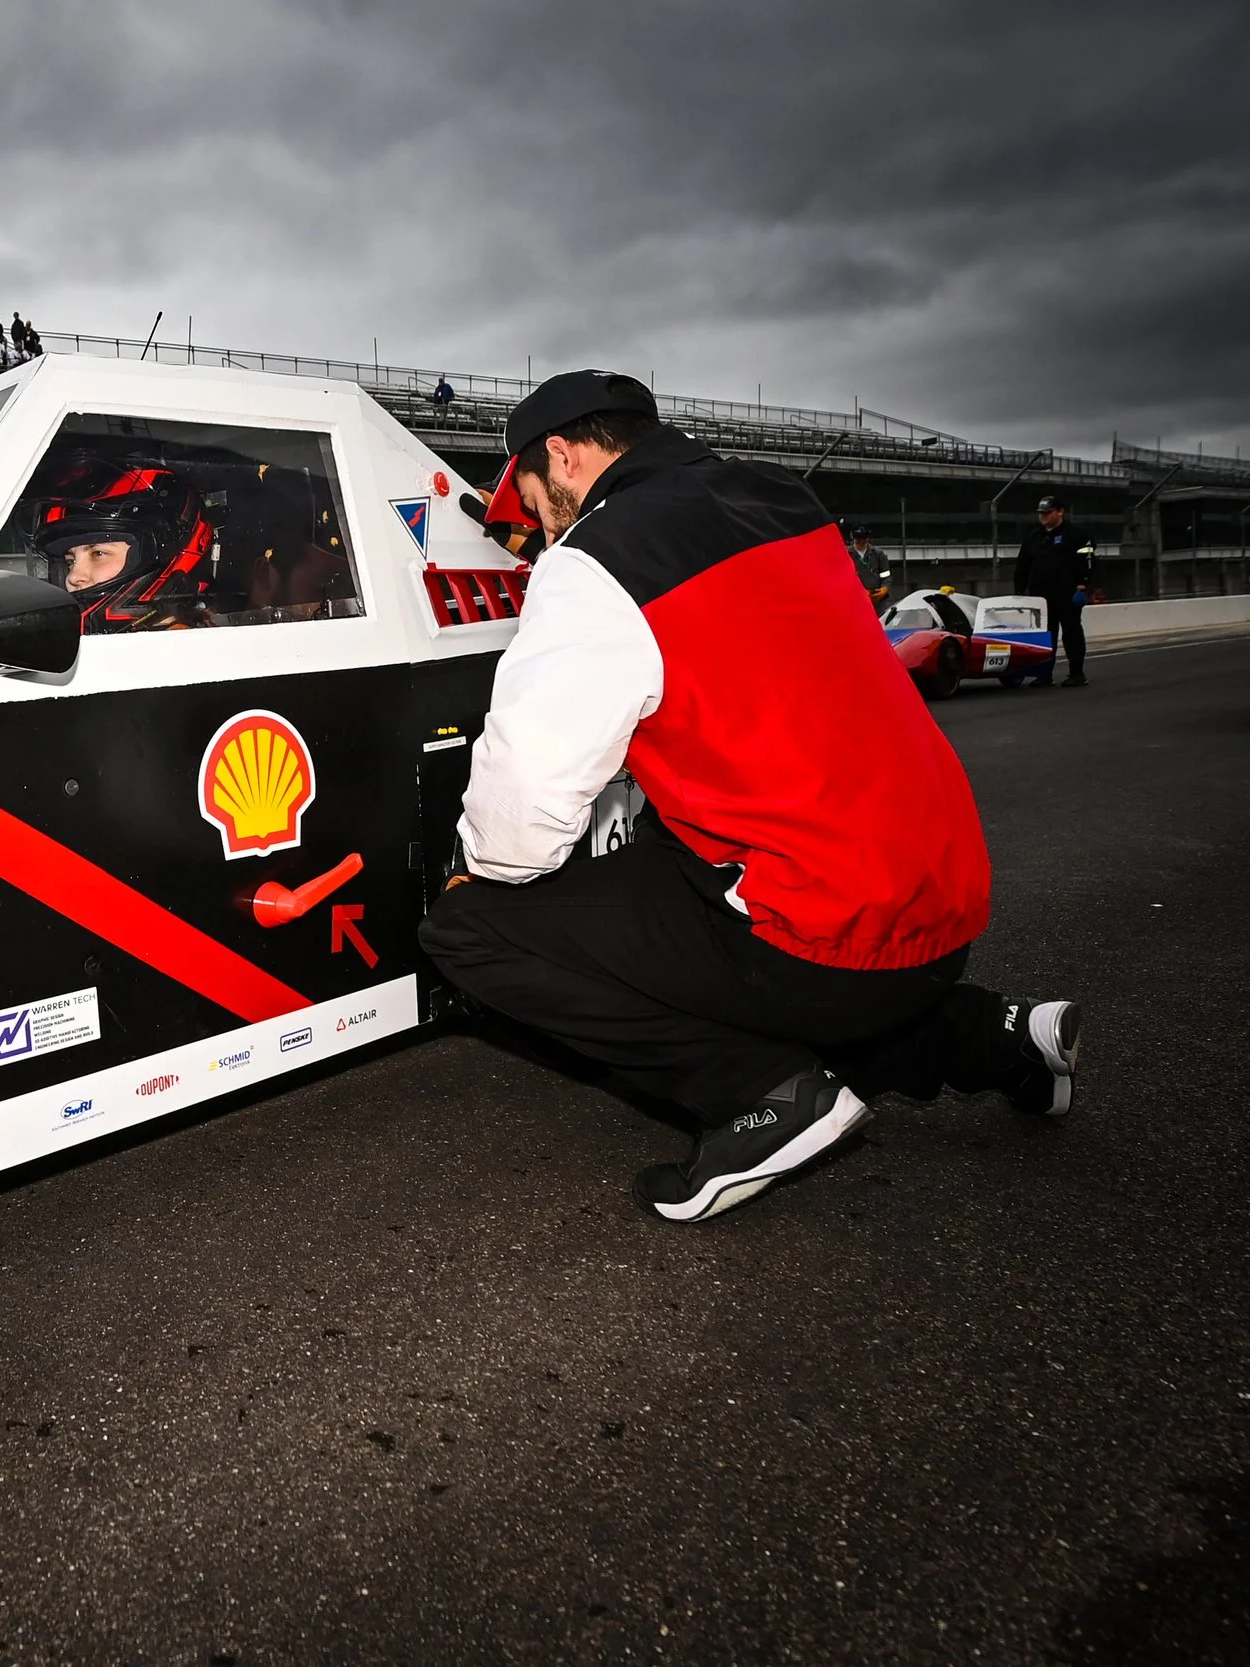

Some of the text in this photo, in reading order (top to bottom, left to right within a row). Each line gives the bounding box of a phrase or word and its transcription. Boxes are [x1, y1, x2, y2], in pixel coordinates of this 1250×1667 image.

[988, 656, 1005, 666] 613
[31, 993, 96, 1015] WARREN TECH
[33, 1022, 53, 1031] PRECISION
[348, 1009, 377, 1026] ALTAIR
[1004, 1005, 1019, 1032] FILA
[283, 1033, 310, 1047] PENSKE
[218, 1050, 250, 1068] SCHMID
[63, 1099, 93, 1118] SwRI
[733, 1108, 778, 1133] FILA
